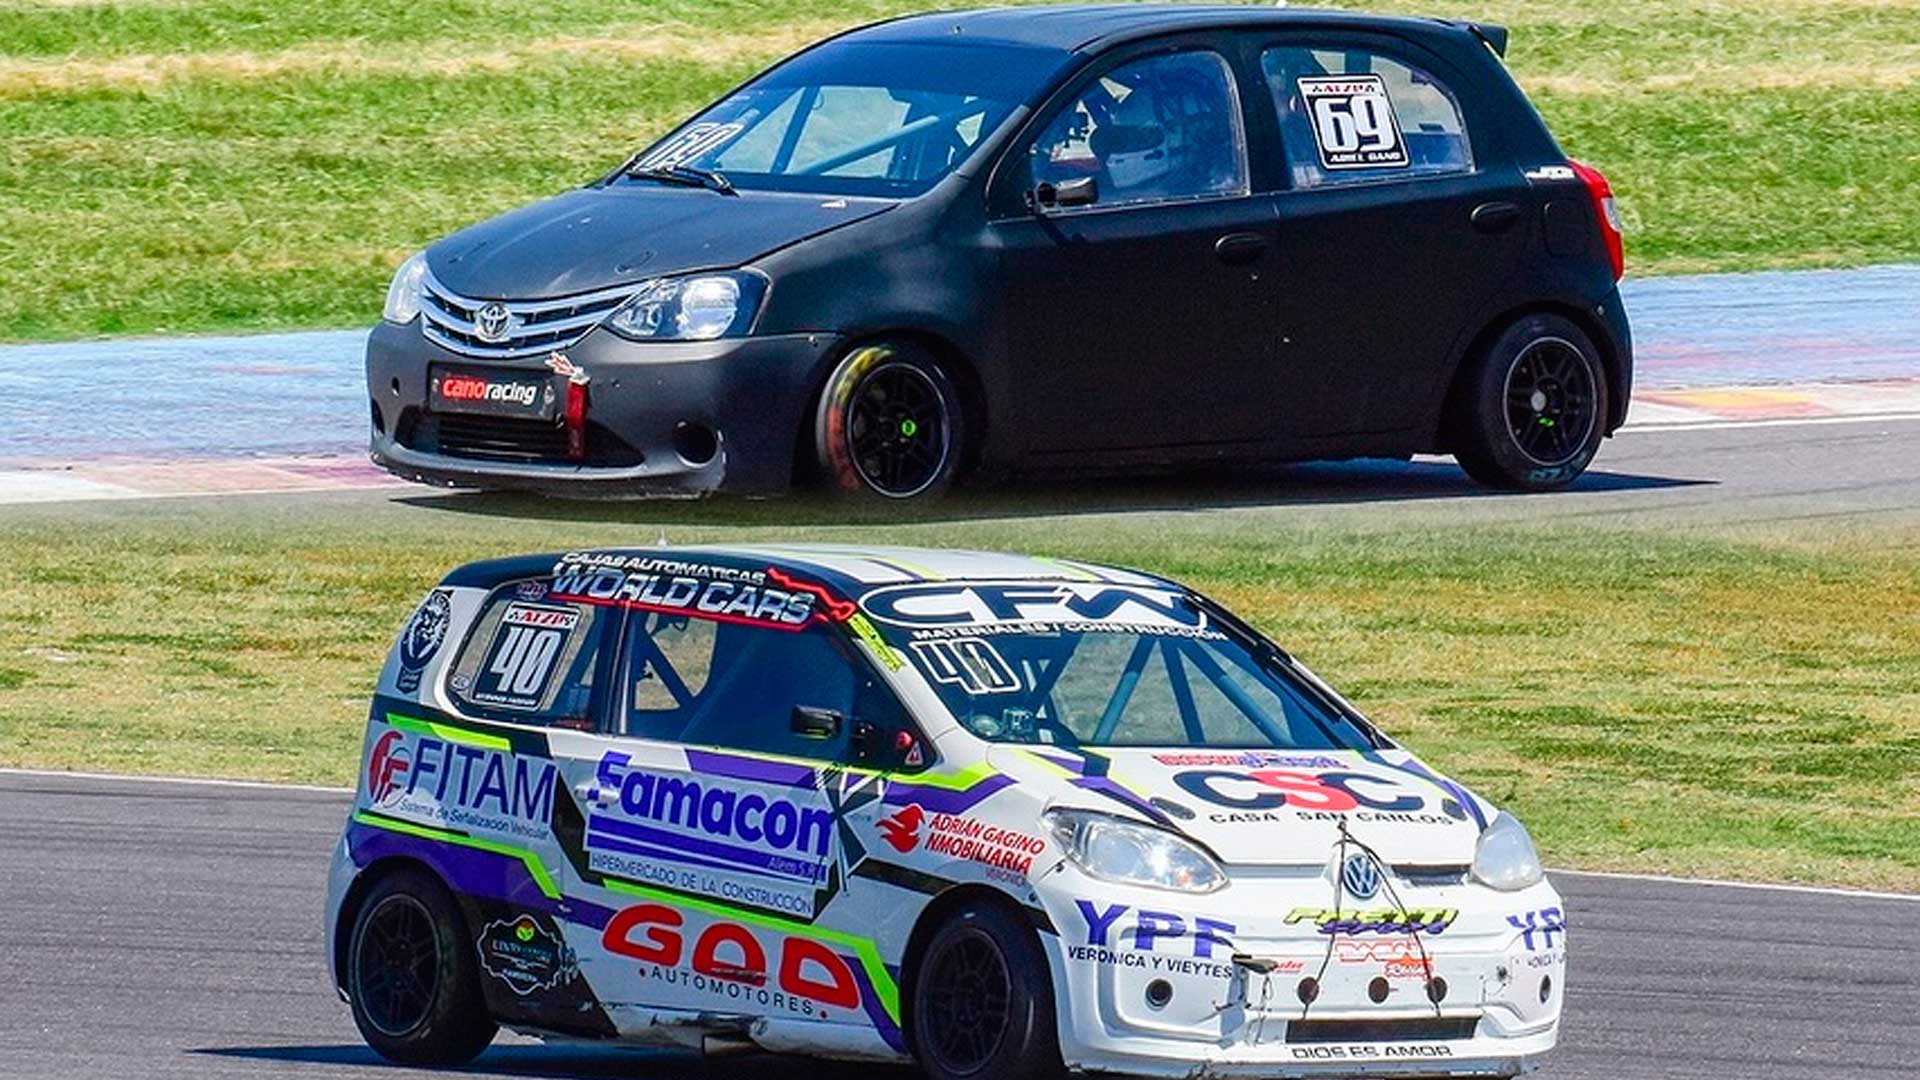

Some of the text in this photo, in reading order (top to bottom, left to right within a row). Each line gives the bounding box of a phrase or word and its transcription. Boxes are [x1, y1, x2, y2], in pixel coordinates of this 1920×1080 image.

[1315, 96, 1396, 152] 69
[443, 379, 537, 405] canoracing
[551, 562, 699, 607] WORLD
[697, 582, 816, 623] CARS
[624, 559, 767, 586] AUTOMATICAS
[489, 627, 562, 695] 40
[910, 638, 1022, 695] 40
[407, 737, 557, 824] FITAM
[1172, 769, 1425, 811] CSC
[587, 750, 834, 858] Famacon
[1209, 811, 1454, 826] CASA SAN CARLOS
[982, 826, 1045, 855] GAGINO
[592, 853, 677, 886] HIPERMERCADO
[681, 871, 697, 888] DE
[701, 877, 717, 893] LA
[1075, 899, 1237, 958] YPF
[1068, 945, 1233, 978] VERONICA Y VIEYTES
[651, 965, 814, 1016] AUTOMOTORES
[1291, 1044, 1453, 1059] DIOS ES AMOR
